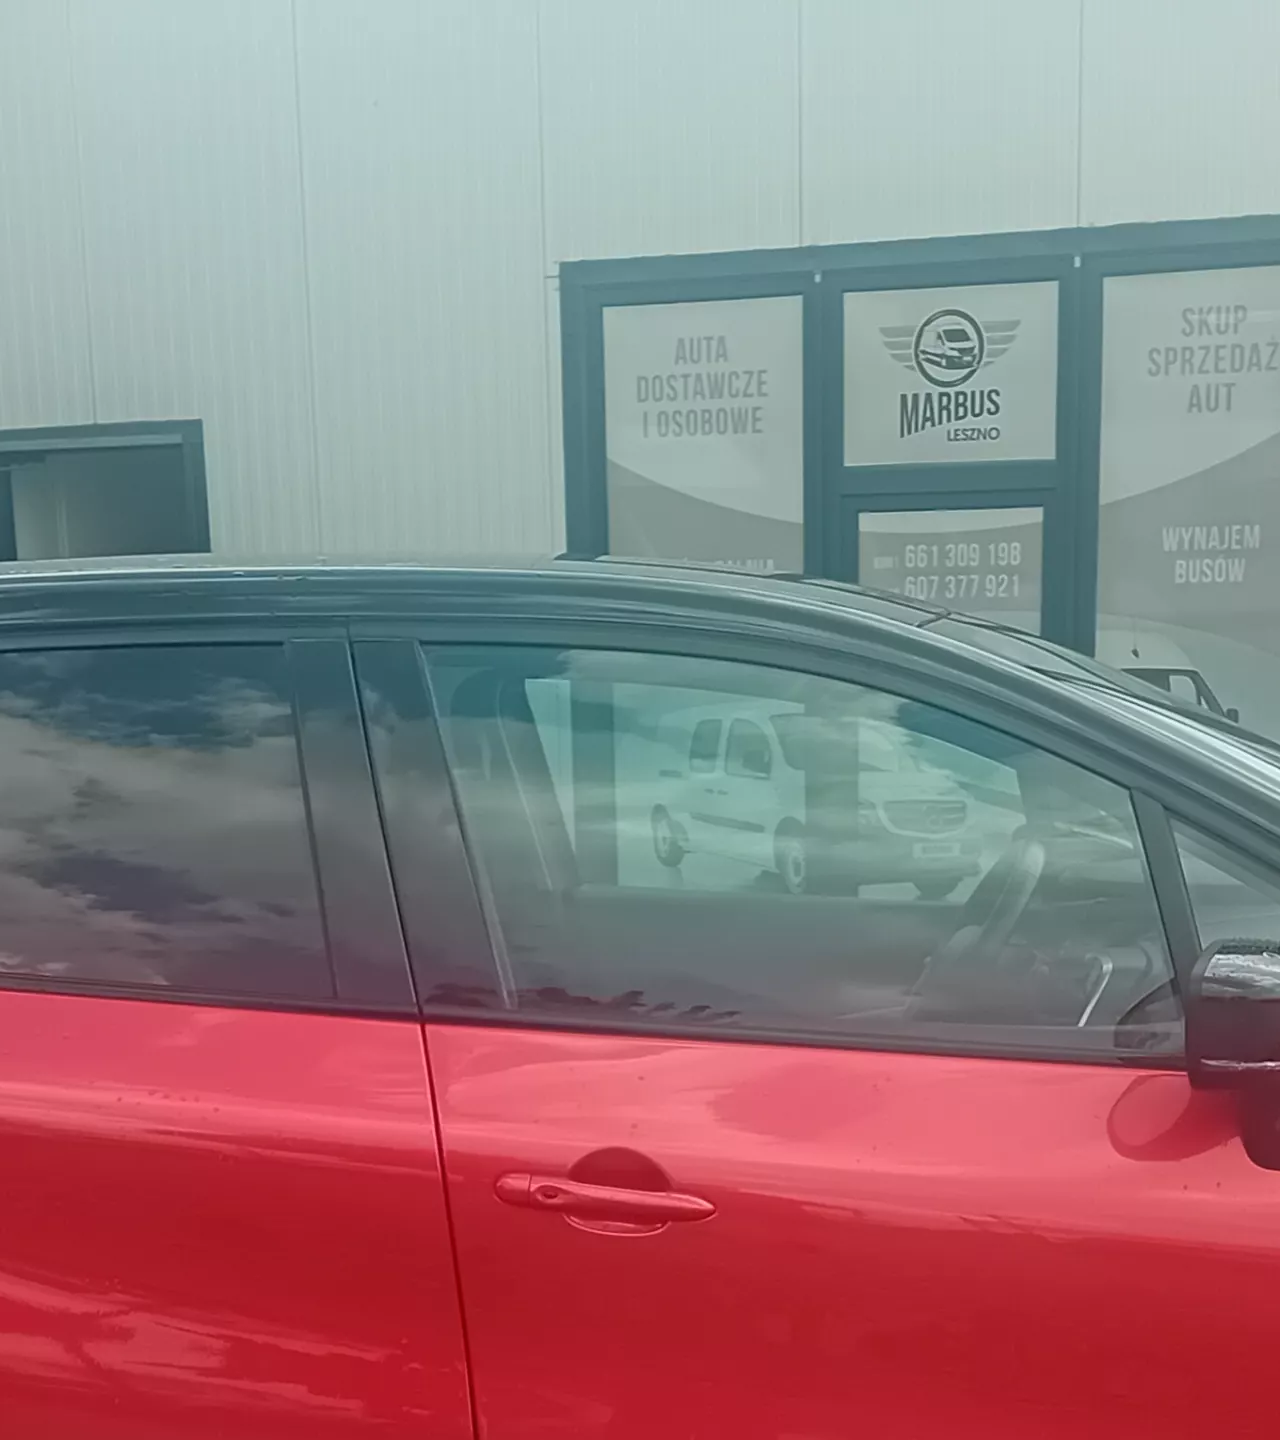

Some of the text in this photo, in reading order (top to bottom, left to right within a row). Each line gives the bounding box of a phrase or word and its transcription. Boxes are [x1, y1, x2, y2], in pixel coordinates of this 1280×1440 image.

[1180, 304, 1248, 338] SKUP
[673, 335, 729, 366] AUTA
[1147, 334, 1280, 378] SPRZEDAŻ
[636, 369, 769, 403] DOSTAWCZE
[1186, 382, 1237, 414] AUT
[642, 406, 764, 439] I OSOBOWE
[899, 388, 1001, 439] MARBUS
[946, 427, 1001, 442] LESZNO
[1162, 524, 1261, 552] WYNAJEM
[905, 544, 939, 568] 661
[944, 543, 980, 567] 309
[988, 541, 1022, 566] 198
[1174, 553, 1246, 584] BUSÓW
[904, 574, 1020, 600] 607 377 921
